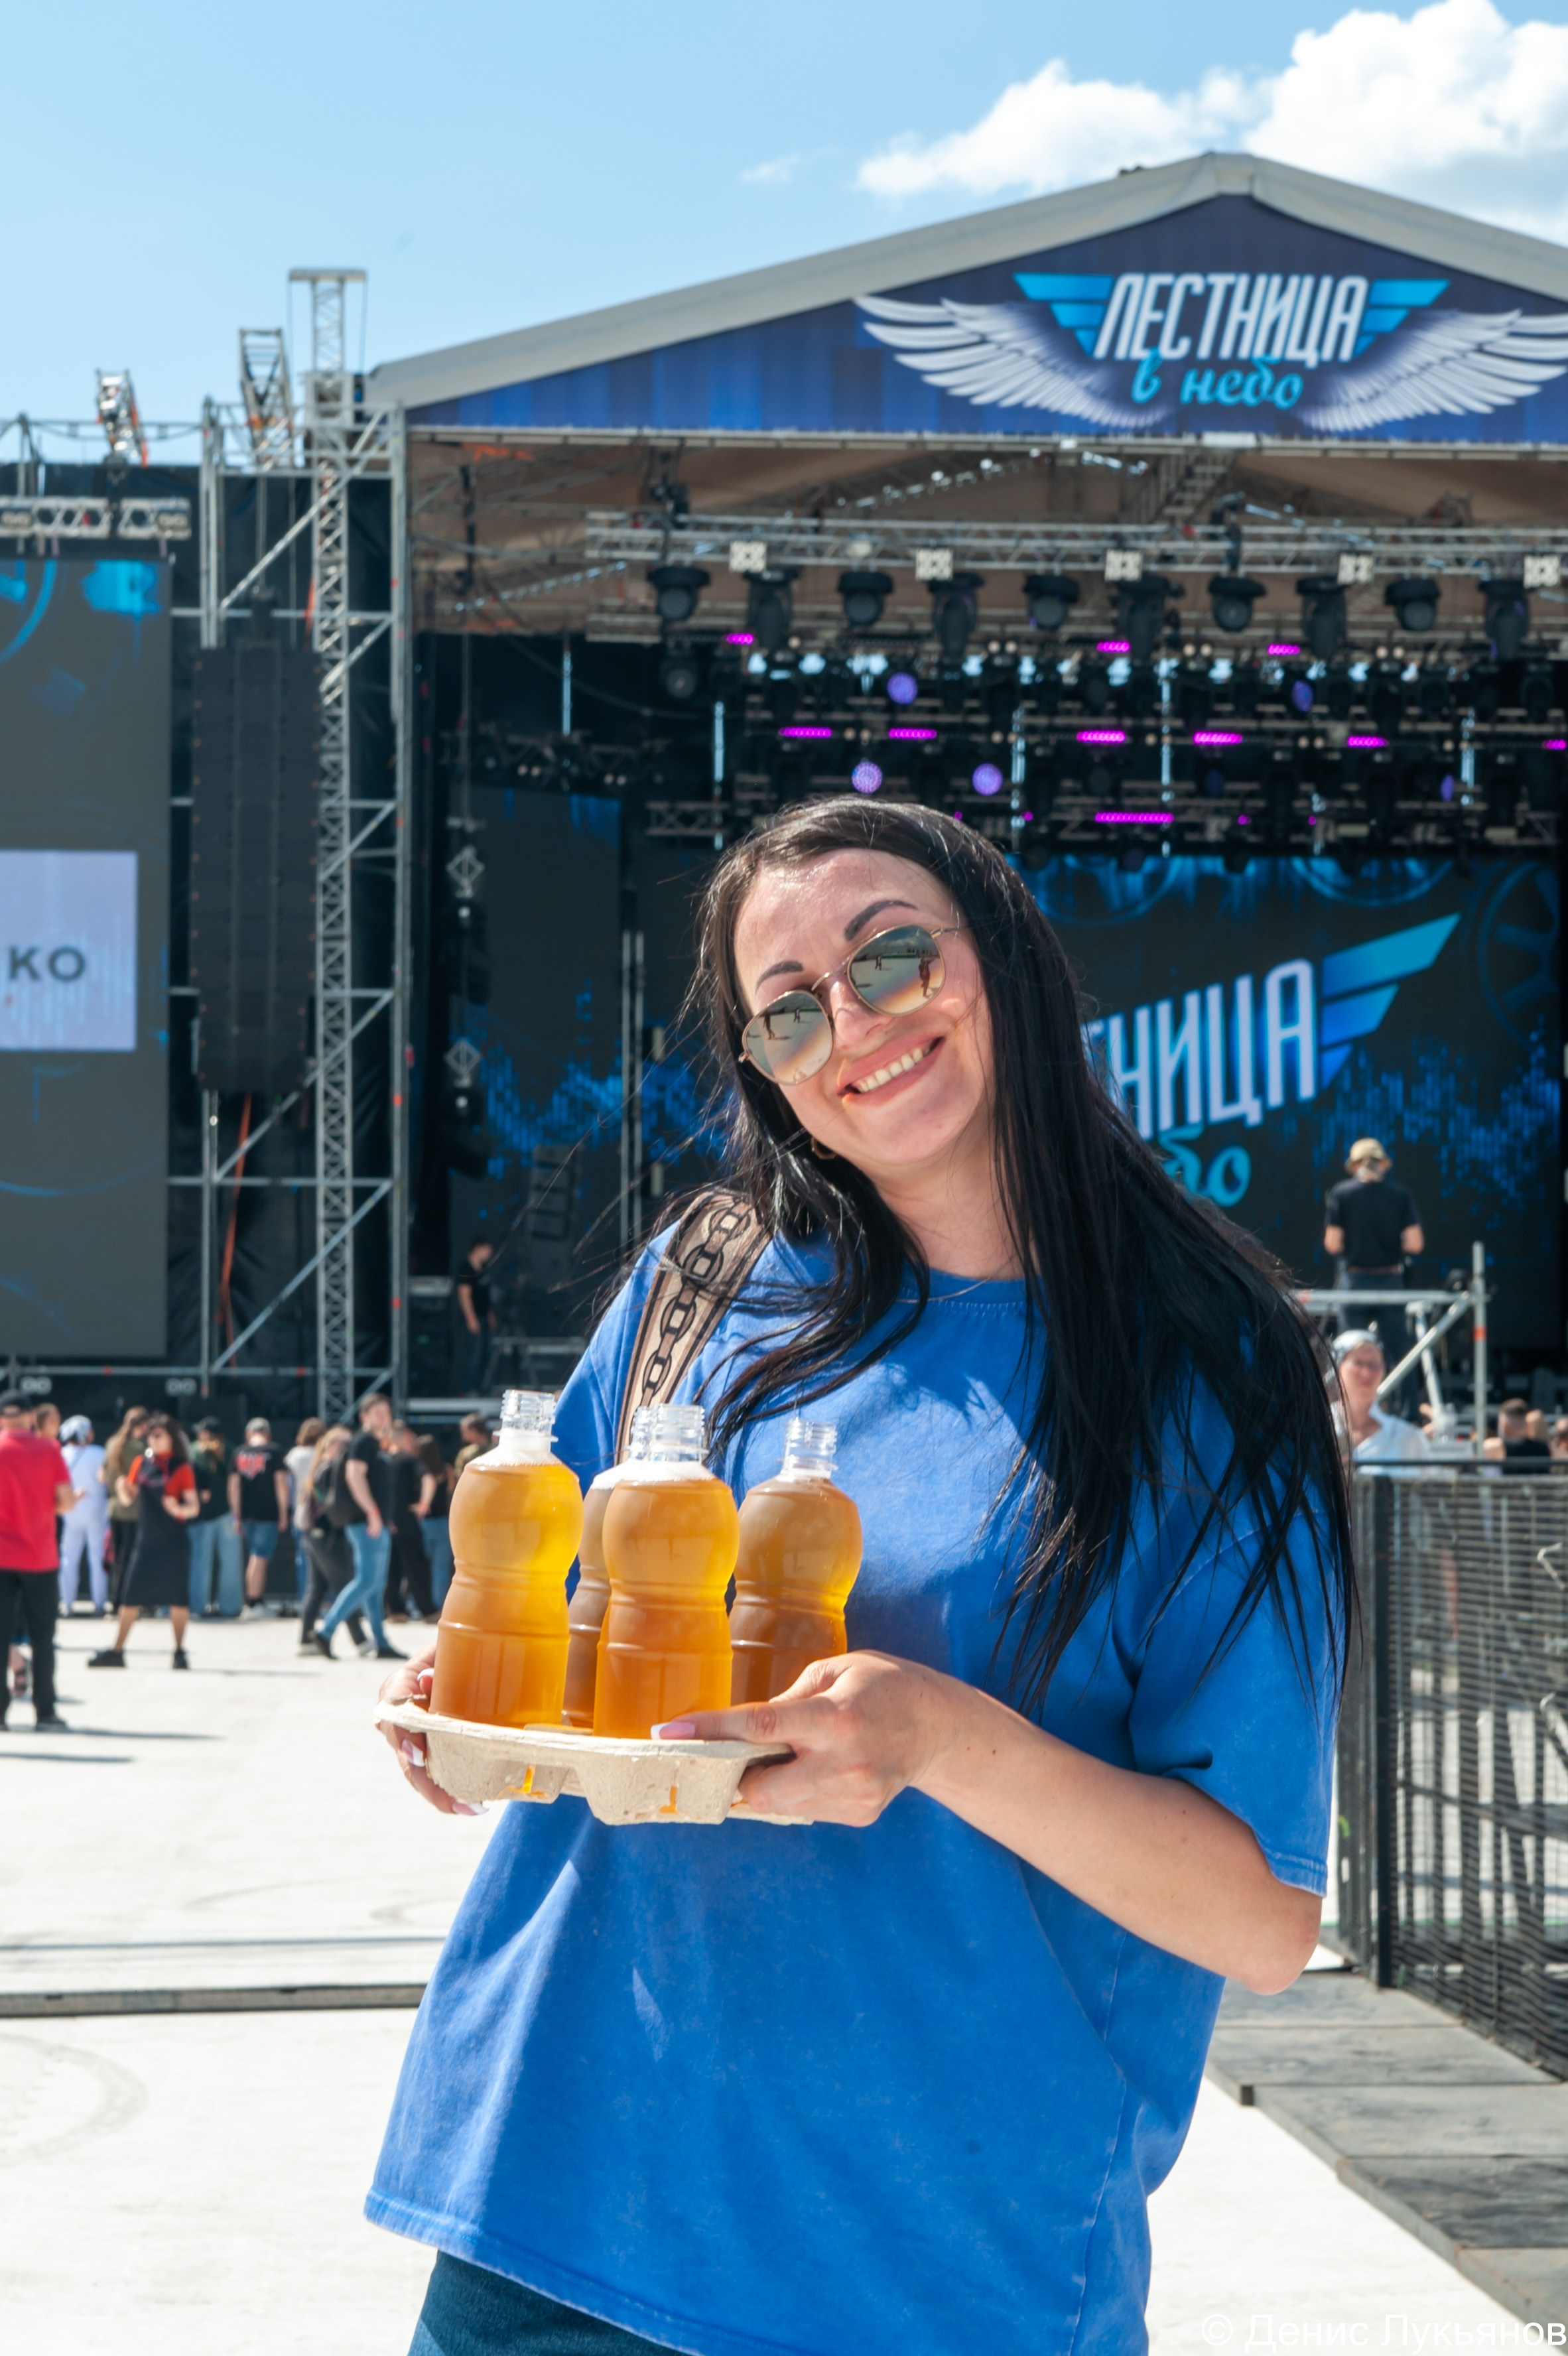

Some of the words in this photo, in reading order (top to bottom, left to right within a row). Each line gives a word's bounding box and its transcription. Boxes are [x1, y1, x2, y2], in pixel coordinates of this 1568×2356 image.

[1093, 272, 1368, 369] ЛЕСТНИЦА
[1132, 347, 1161, 405] в
[1180, 353, 1303, 410] небо
[1159, 1123, 1252, 1208] бо
